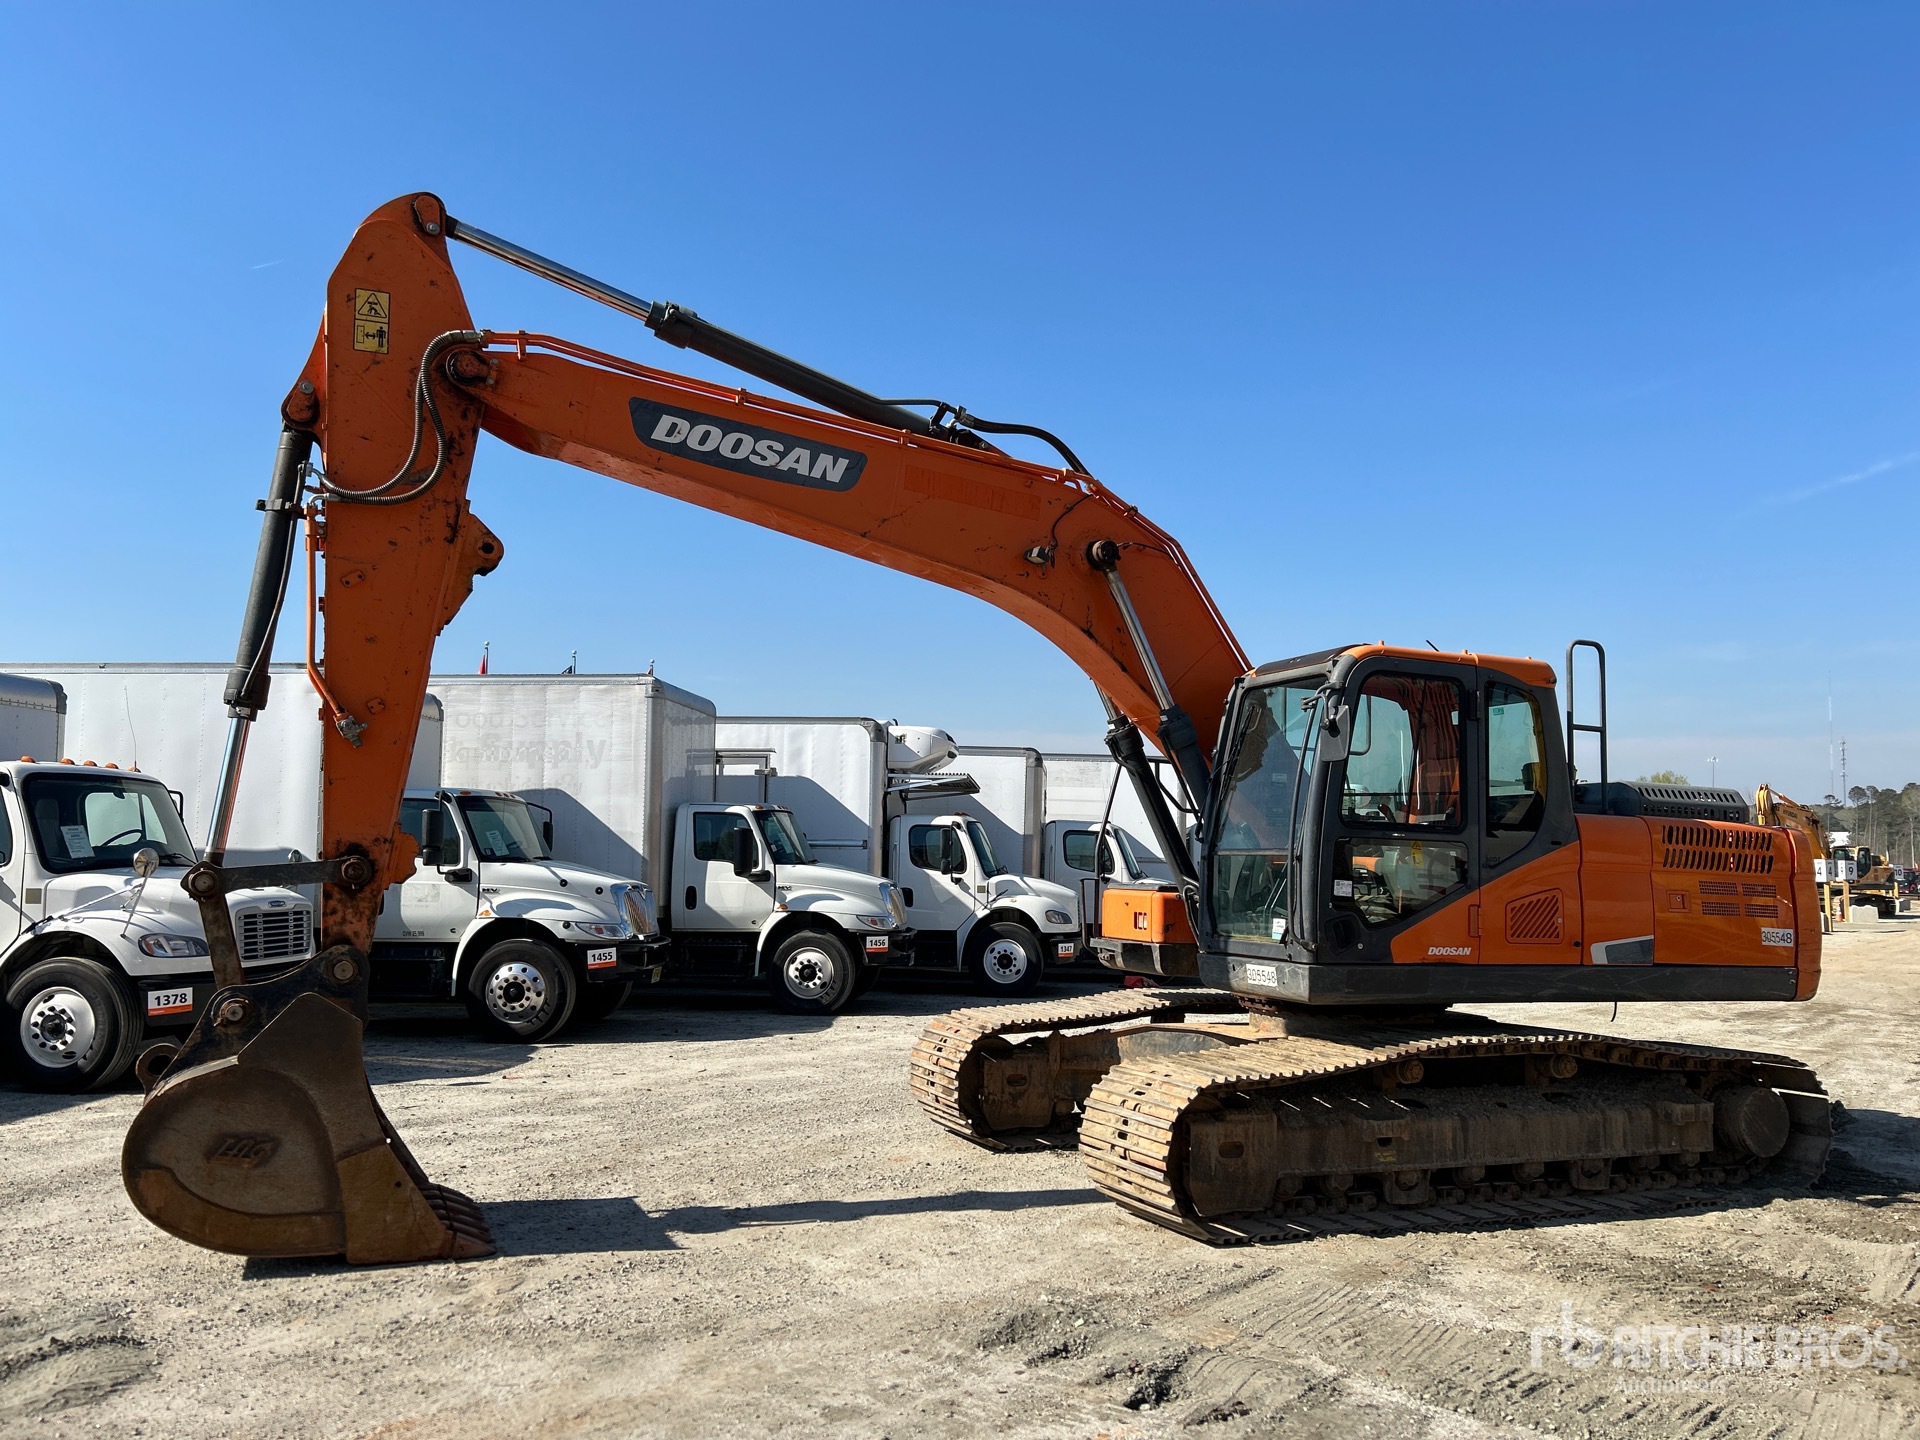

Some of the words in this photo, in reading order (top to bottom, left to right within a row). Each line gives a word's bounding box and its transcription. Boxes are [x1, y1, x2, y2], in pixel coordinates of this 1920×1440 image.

[650, 414, 850, 483] DOOSAN
[1816, 866, 1822, 876] 4
[1848, 866, 1854, 876] 9
[1894, 868, 1902, 877] 10
[1761, 930, 1793, 944] 305548
[869, 939, 886, 947] 1456
[1427, 946, 1472, 956] DOOSAN
[591, 951, 613, 962] 1455
[154, 992, 188, 1007] 1378
